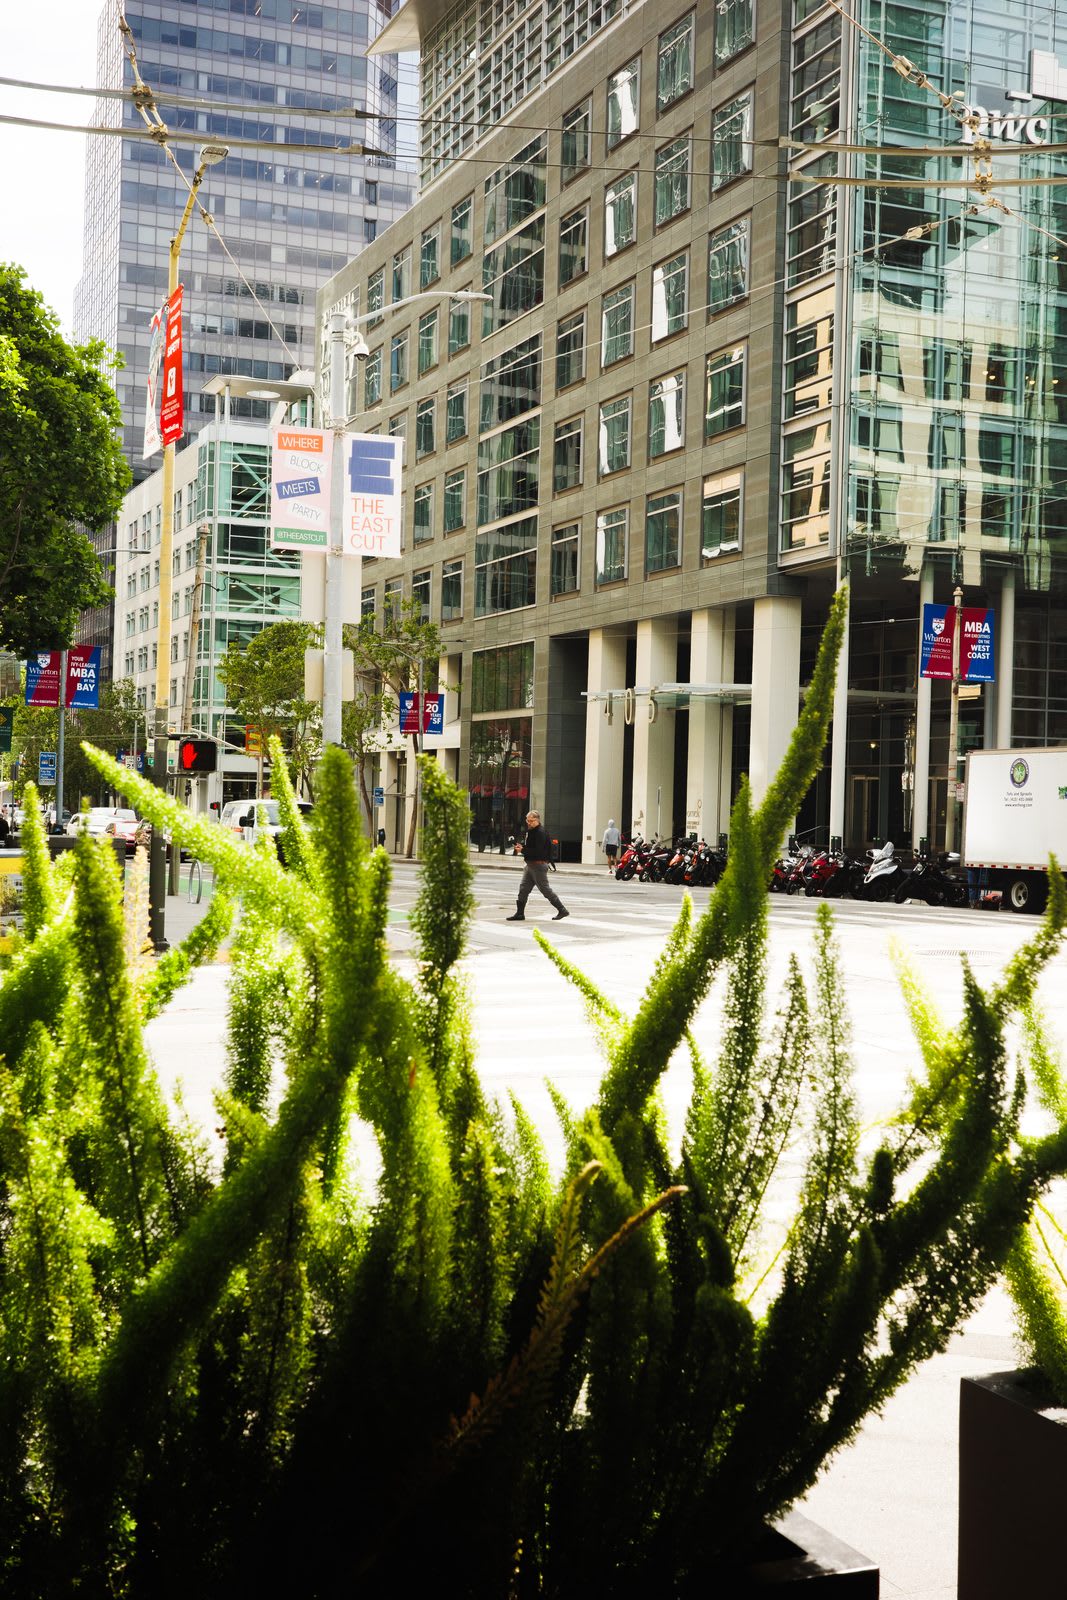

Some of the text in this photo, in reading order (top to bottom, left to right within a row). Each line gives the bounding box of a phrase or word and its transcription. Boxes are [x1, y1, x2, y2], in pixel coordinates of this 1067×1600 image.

[281, 436, 319, 449] WHERE
[290, 455, 324, 473] BLOCK
[282, 480, 316, 496] MEETS
[291, 503, 321, 521] PARTY
[351, 498, 385, 515] THE
[351, 516, 393, 533] EAST
[276, 529, 325, 542] @THEEASTCUT
[350, 533, 387, 551] CUT
[964, 621, 991, 633] MBA
[924, 633, 951, 644] Wharton
[28, 667, 58, 675] Wharton
[70, 668, 96, 678] MBA
[76, 683, 95, 691] BAY
[425, 704, 439, 713] 20
